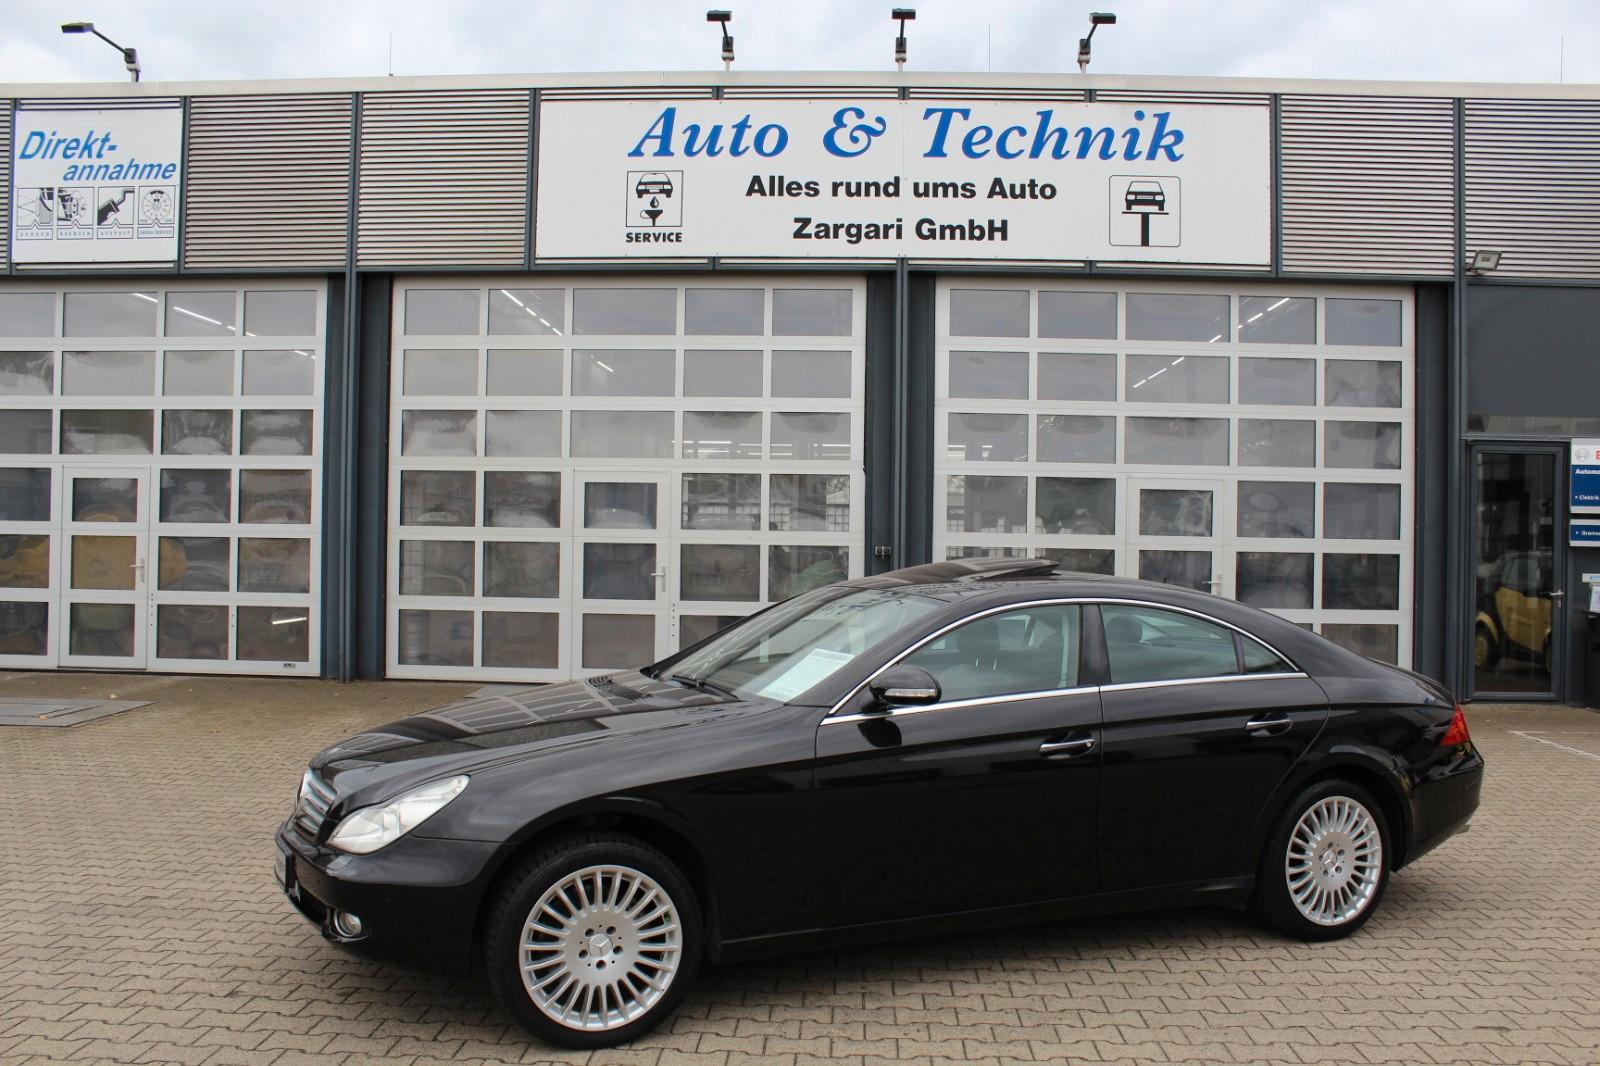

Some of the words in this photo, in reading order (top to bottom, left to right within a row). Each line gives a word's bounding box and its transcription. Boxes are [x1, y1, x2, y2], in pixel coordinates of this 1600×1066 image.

[18, 130, 117, 159] Direkt-
[627, 106, 789, 158] Auto
[822, 106, 887, 158] &
[923, 107, 1184, 162] Technik
[63, 158, 177, 181] annahme
[746, 175, 820, 198] Alles
[831, 176, 901, 198] rund
[913, 181, 977, 199] ums
[986, 177, 1057, 200] Auto
[625, 232, 683, 243] SERVICE
[792, 217, 903, 244] Zargari
[915, 218, 1008, 242] GmbH
